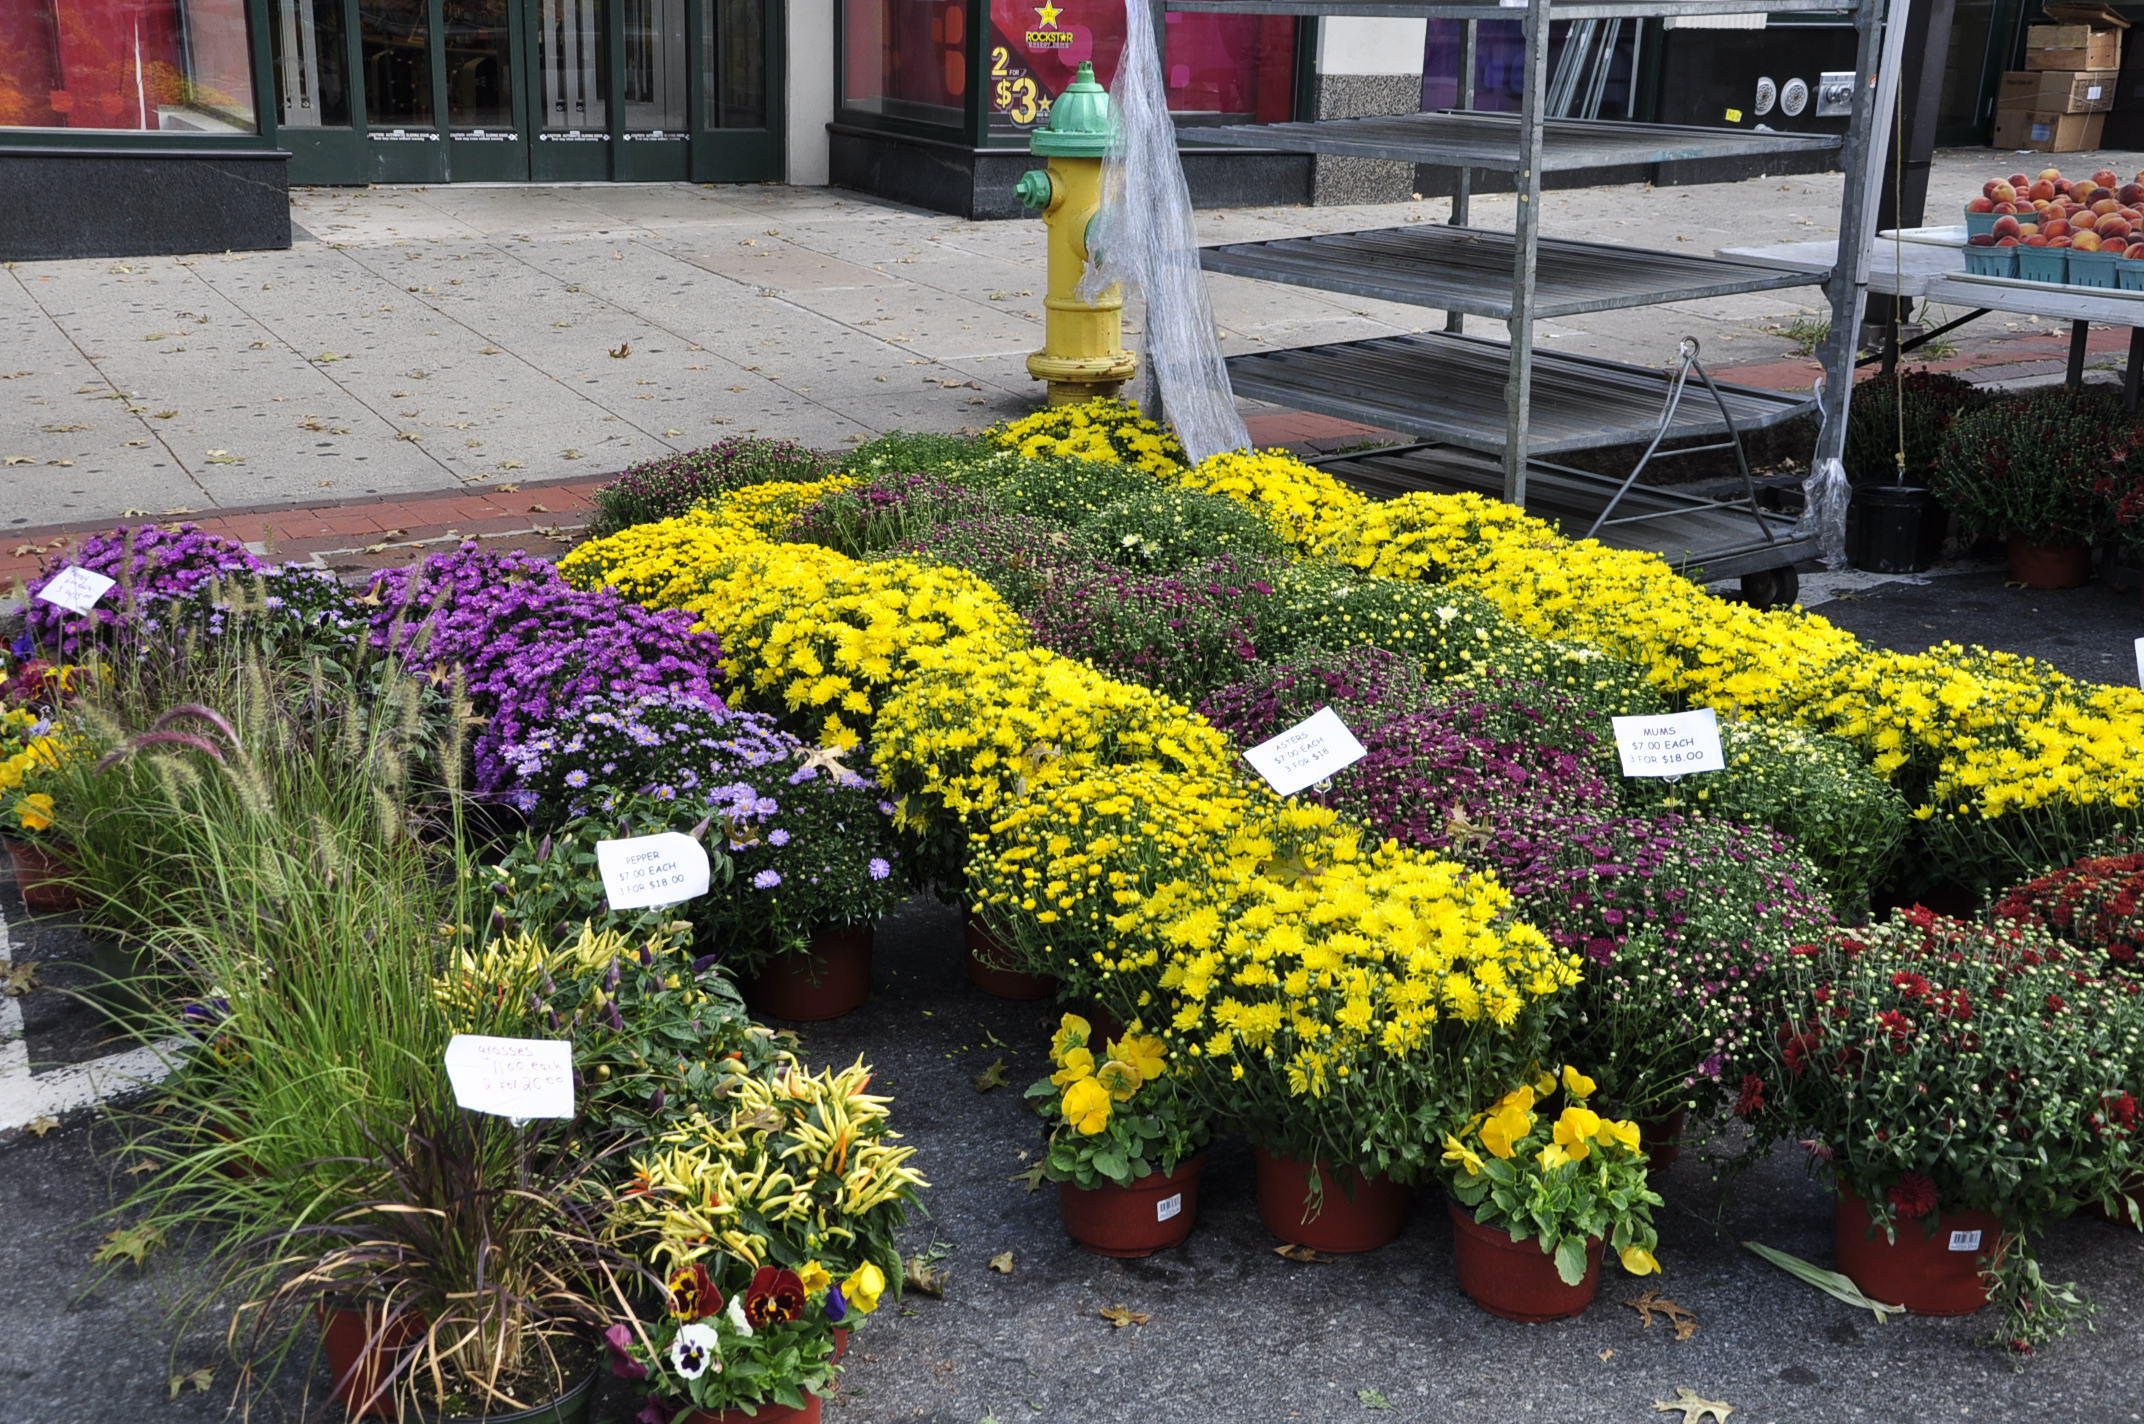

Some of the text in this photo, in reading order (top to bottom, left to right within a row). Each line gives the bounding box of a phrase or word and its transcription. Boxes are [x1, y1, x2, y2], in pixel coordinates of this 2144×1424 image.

[992, 47, 1008, 76] 2
[996, 77, 1036, 124] $3
[1275, 732, 1309, 751] ASTERS
[1643, 727, 1676, 737] MUMS
[1274, 736, 1324, 765] $700 EACH
[1632, 738, 1694, 751] $700 EACH
[1284, 747, 1330, 773] 3 FOR $18
[1630, 751, 1703, 764] 3 FOR $18.00
[625, 851, 660, 865] PEPPER
[619, 861, 677, 882] $700 EACH
[627, 883, 646, 893] FOR
[649, 874, 685, 889] $1800
